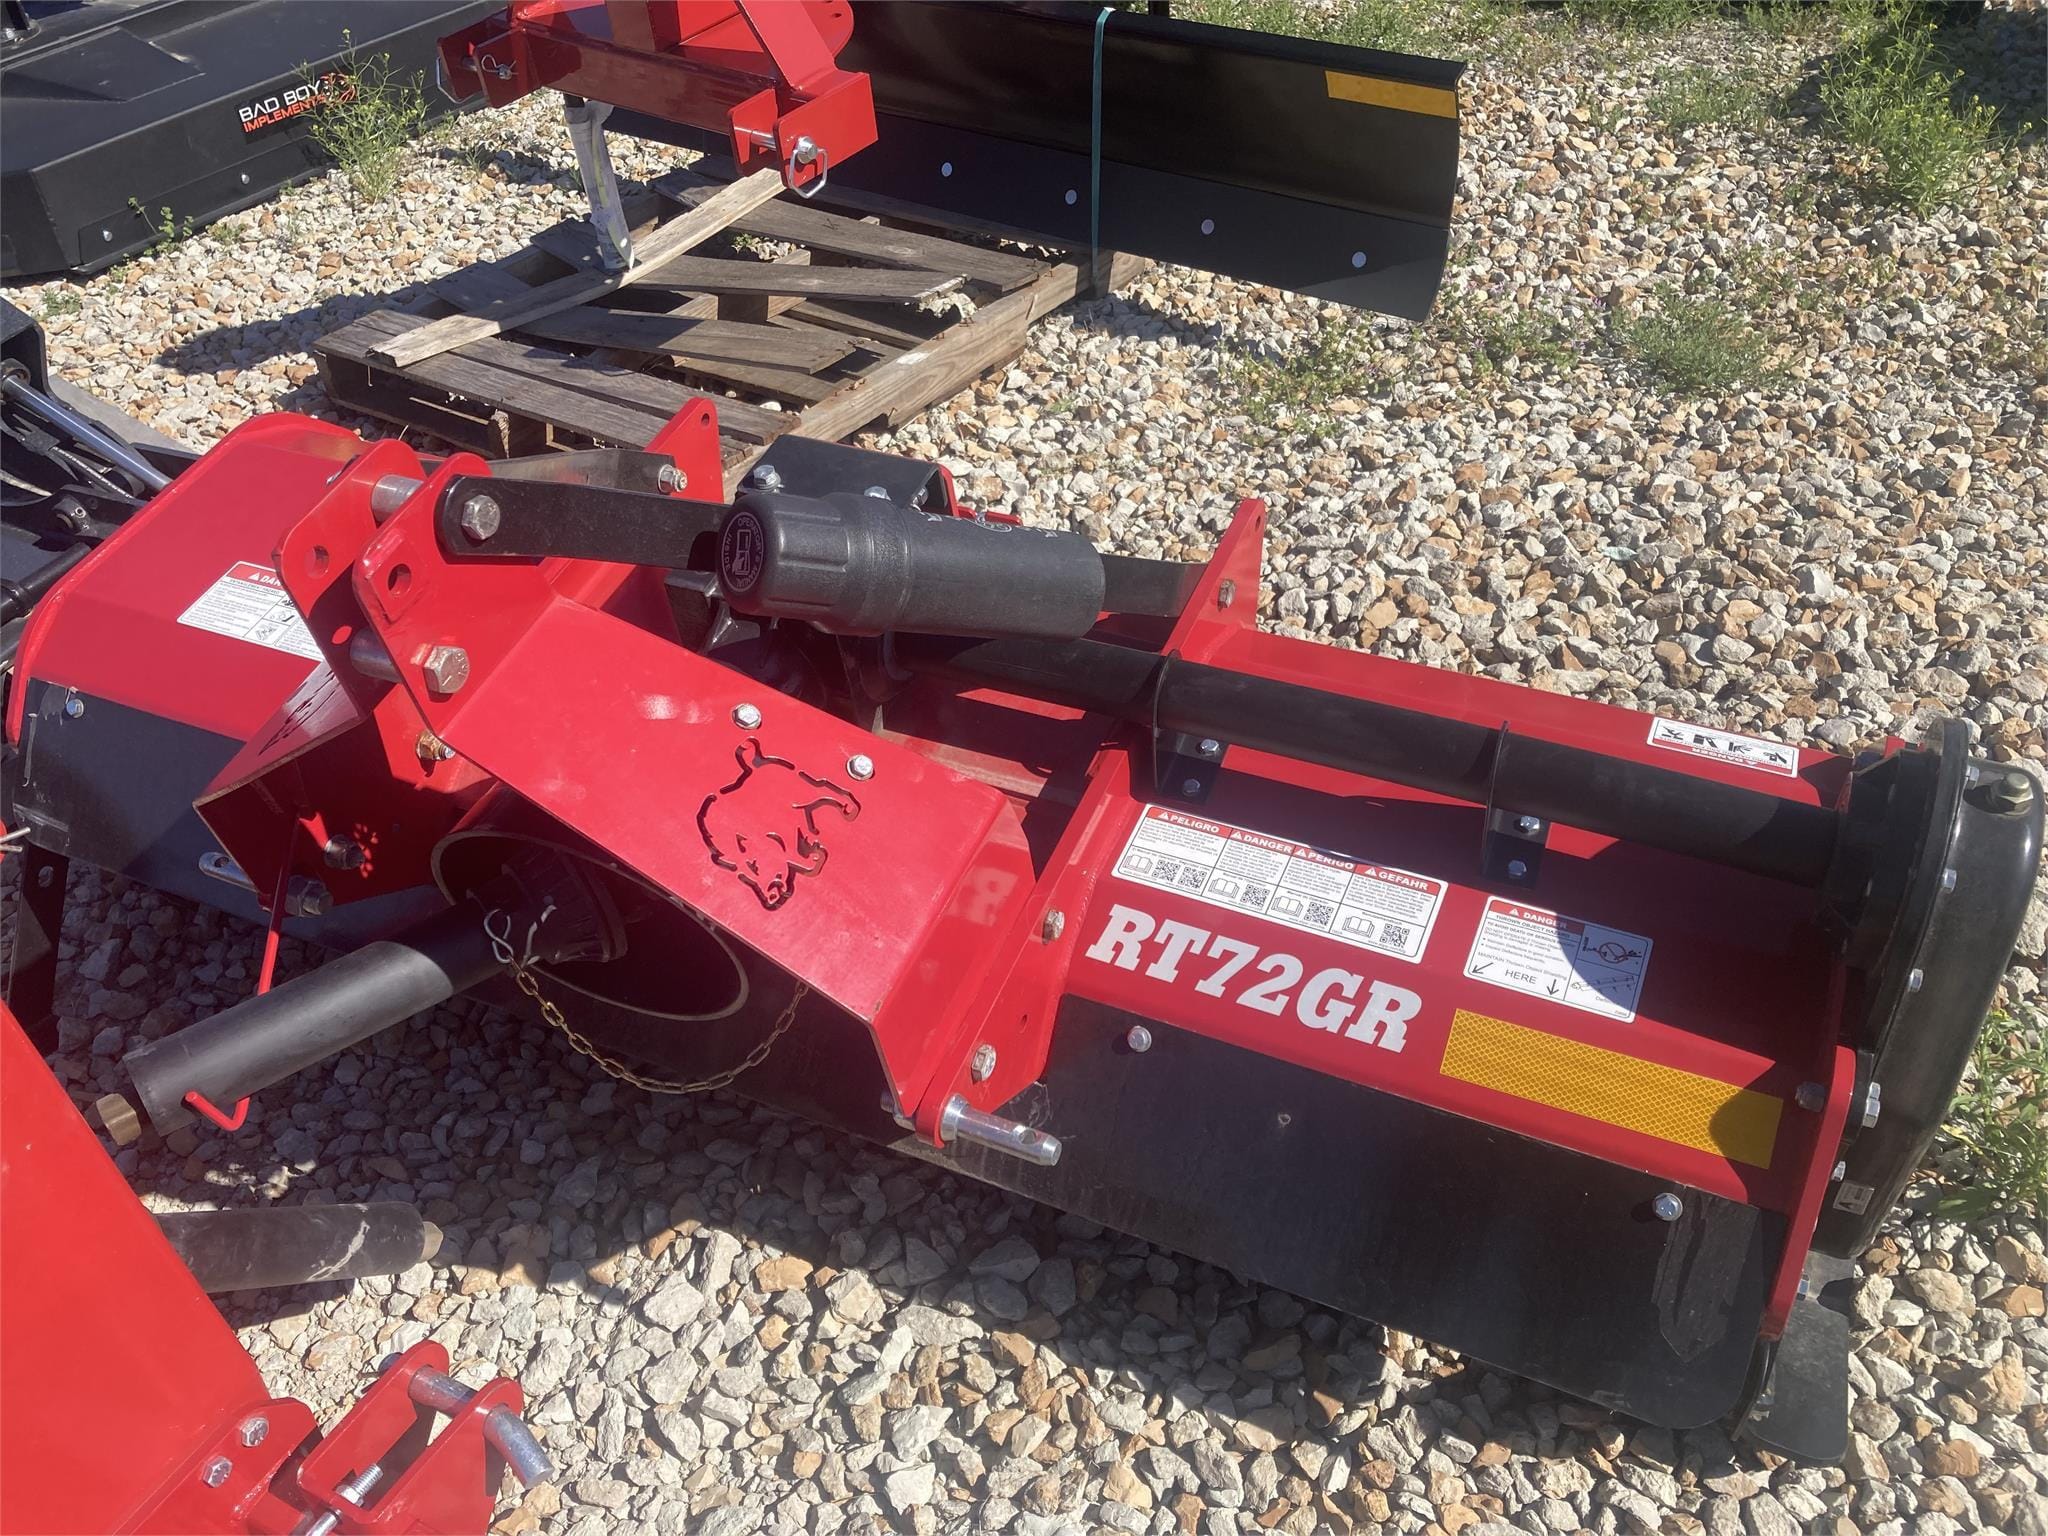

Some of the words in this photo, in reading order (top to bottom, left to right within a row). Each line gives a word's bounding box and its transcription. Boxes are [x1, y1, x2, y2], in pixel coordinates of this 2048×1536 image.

[239, 97, 280, 122] BAD
[283, 80, 321, 106] BOY
[243, 94, 327, 133] IMPLEMENTS
[260, 574, 282, 587] DAN
[1692, 748, 1745, 763] DANGER
[1169, 815, 1220, 834] PELIGRO
[1242, 834, 1294, 854] DANGER
[1306, 851, 1355, 870] PERIGO
[1378, 870, 1429, 891] GEFAHR
[1523, 912, 1567, 929] DANGER
[1085, 903, 1423, 1053] RT72GR
[1504, 969, 1537, 985] HERE
